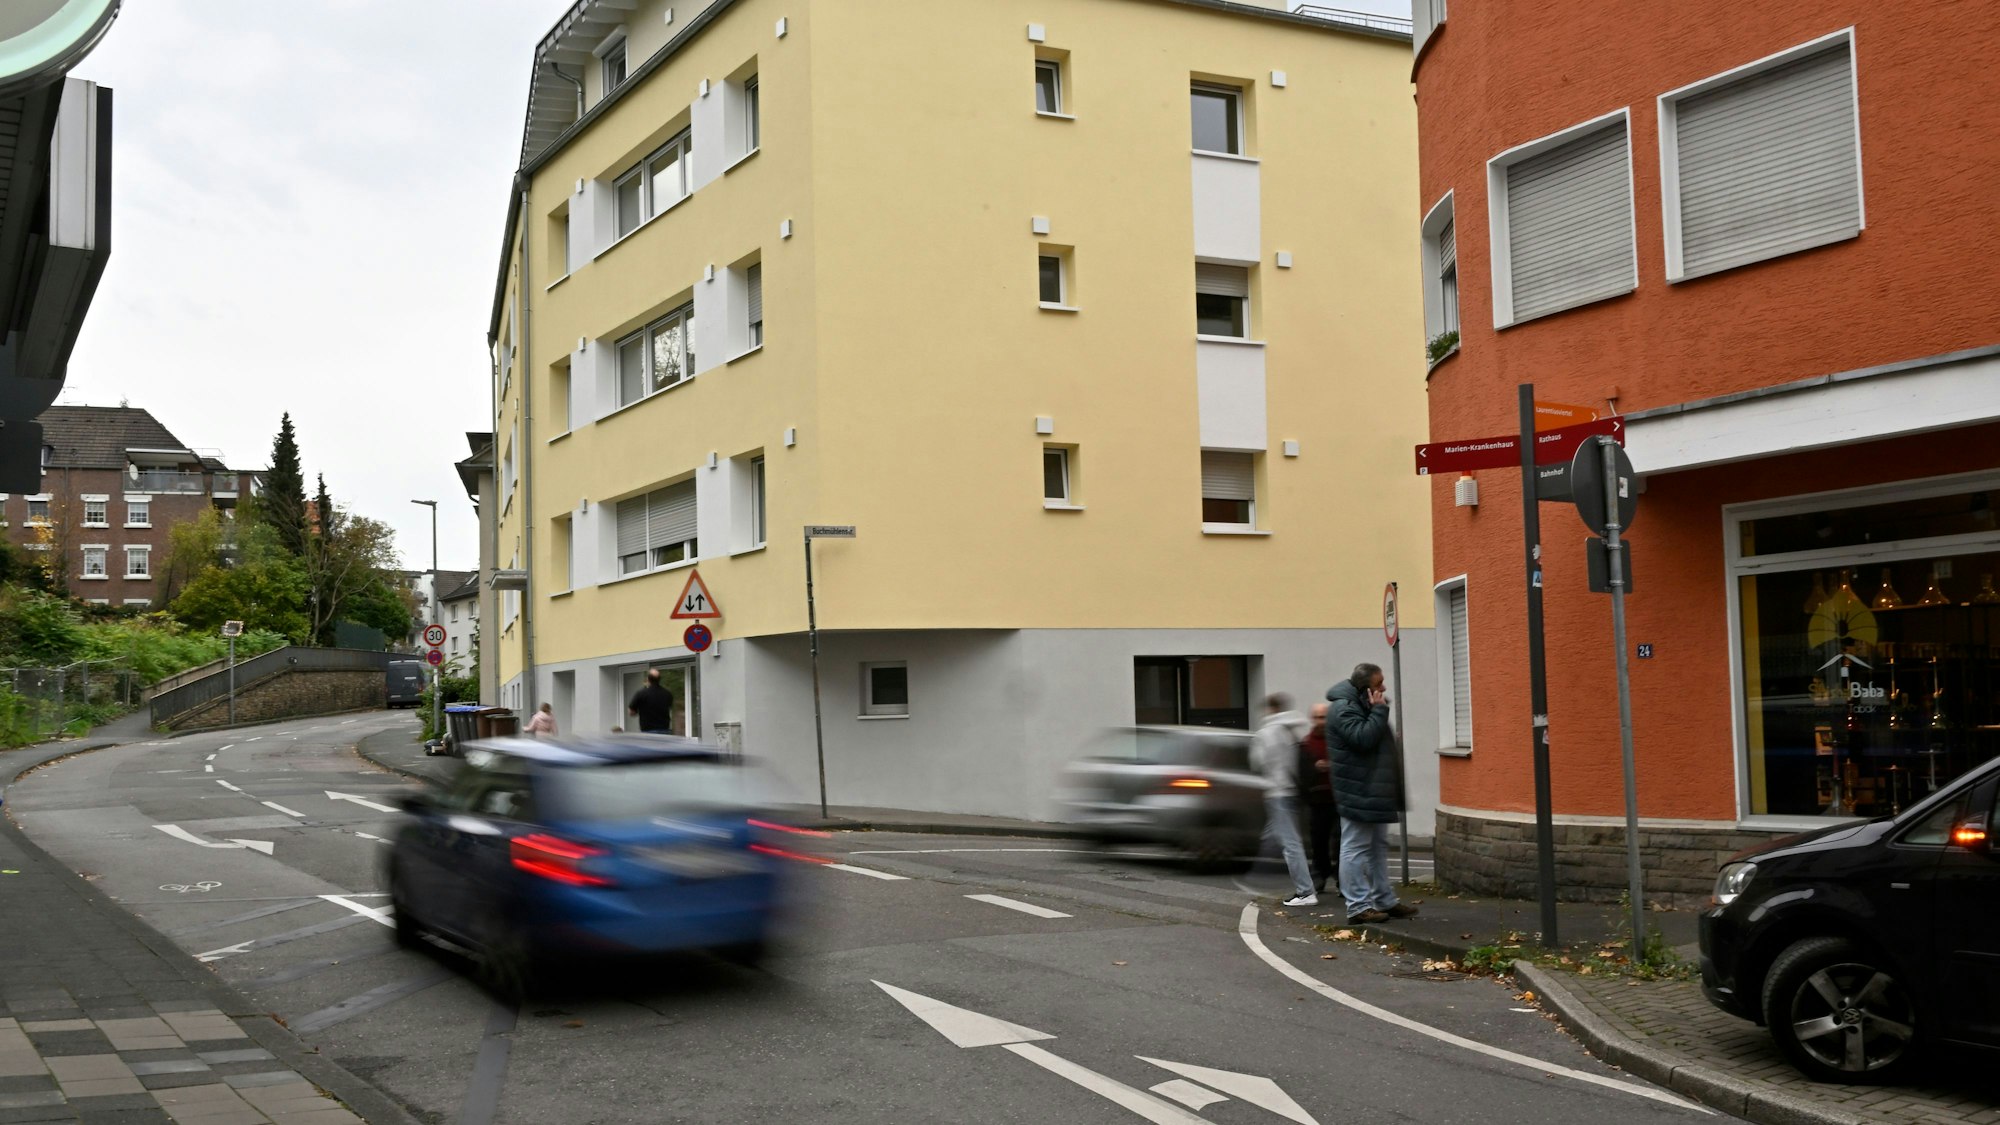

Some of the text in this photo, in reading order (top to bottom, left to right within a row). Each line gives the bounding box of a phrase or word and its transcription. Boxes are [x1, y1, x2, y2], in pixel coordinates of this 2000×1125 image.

[1538, 433, 1562, 444] Rathaus
[1444, 441, 1514, 454] Marien-Krankenhaus
[1540, 467, 1564, 478] Bahnhof
[428, 630, 442, 641] 30
[1639, 645, 1650, 656] 24
[1850, 681, 1885, 698] Baba
